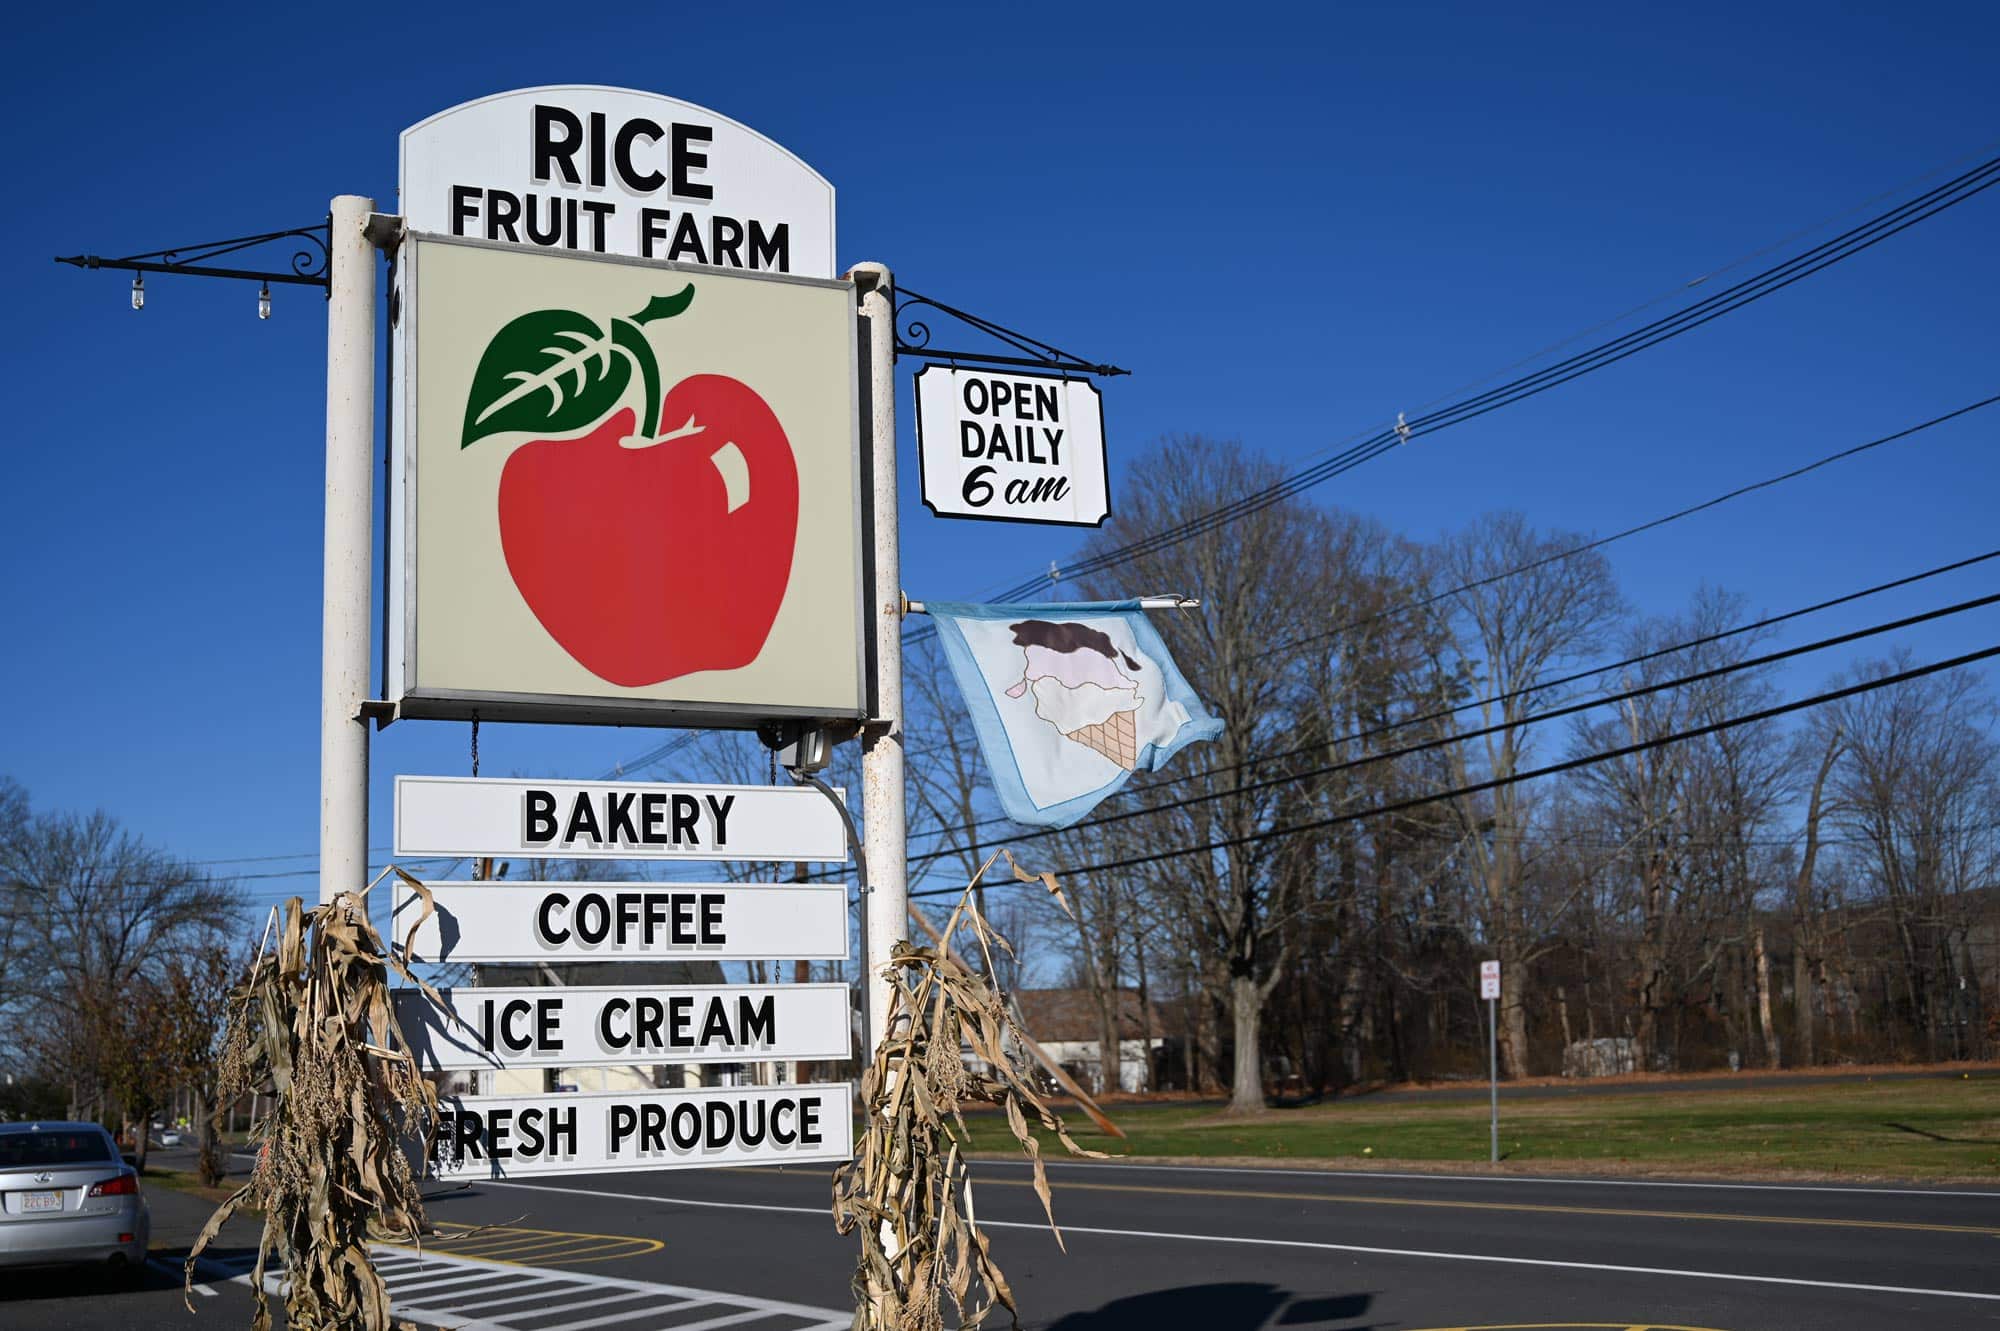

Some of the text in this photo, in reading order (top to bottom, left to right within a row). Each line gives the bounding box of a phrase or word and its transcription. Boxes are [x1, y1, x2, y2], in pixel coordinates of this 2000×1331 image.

[534, 103, 713, 200] RICE
[452, 184, 790, 273] FRUIT FARM
[963, 378, 1059, 423] OPEN
[960, 420, 1064, 465] DAILY
[962, 465, 1070, 507] 6 am
[525, 790, 735, 845] BAKERY
[538, 893, 726, 945] COFFEE
[484, 996, 776, 1052] ICE CREAM
[430, 1097, 822, 1161] FRESH PRODUCE
